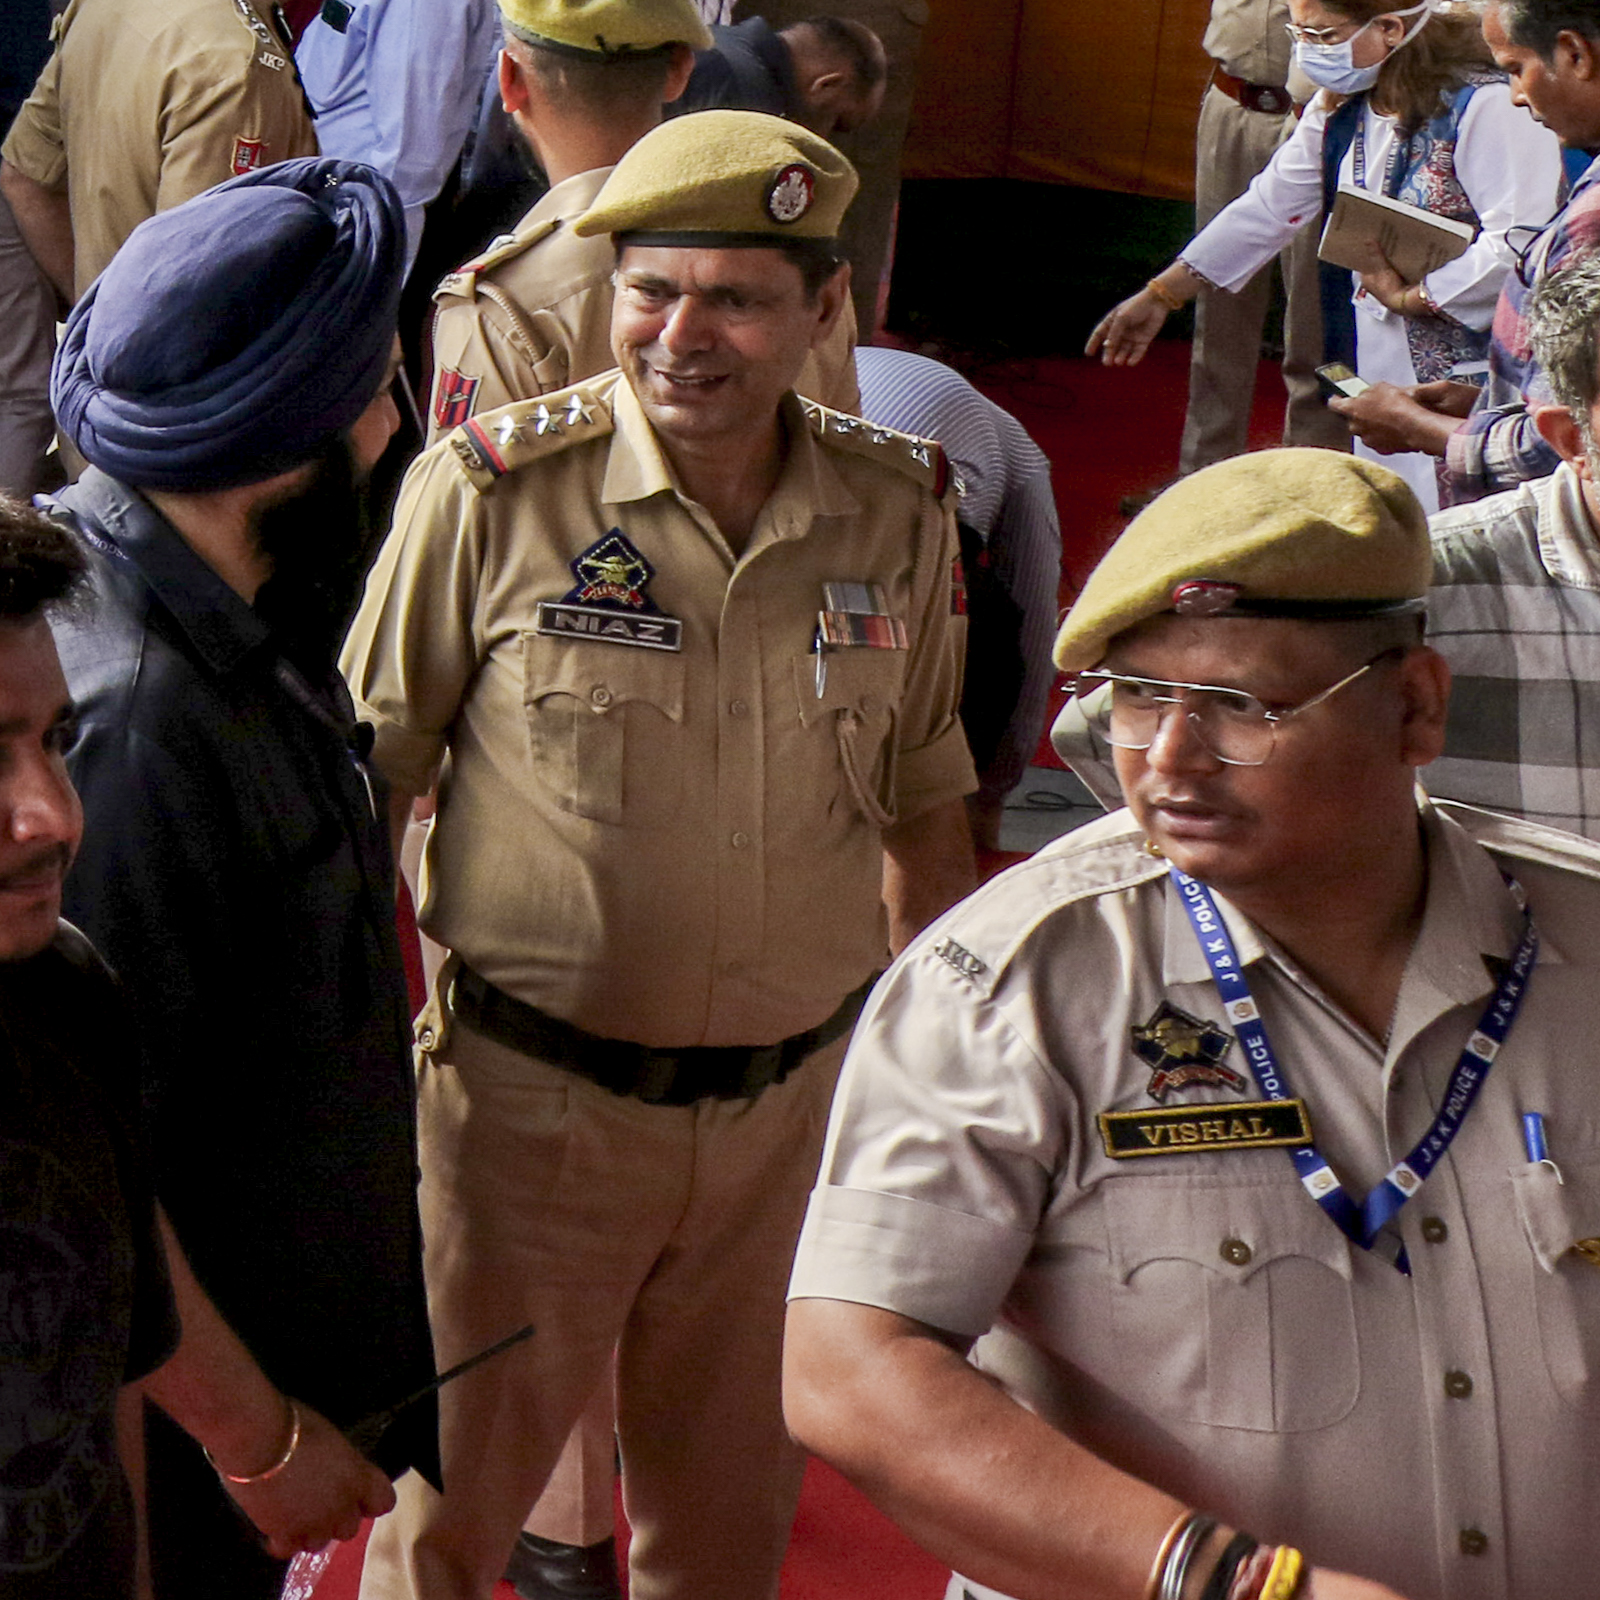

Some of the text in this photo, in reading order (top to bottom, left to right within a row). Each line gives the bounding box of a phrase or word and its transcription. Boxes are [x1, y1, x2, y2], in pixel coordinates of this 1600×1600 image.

[259, 51, 286, 71] JKP
[554, 611, 665, 642] NIAZ
[1207, 938, 1226, 953] K
[1215, 954, 1232, 968] &
[1221, 972, 1239, 982] J
[1246, 1035, 1286, 1101] POLICE
[1445, 1066, 1478, 1120] POLICE
[1138, 1117, 1274, 1146] VISHAL
